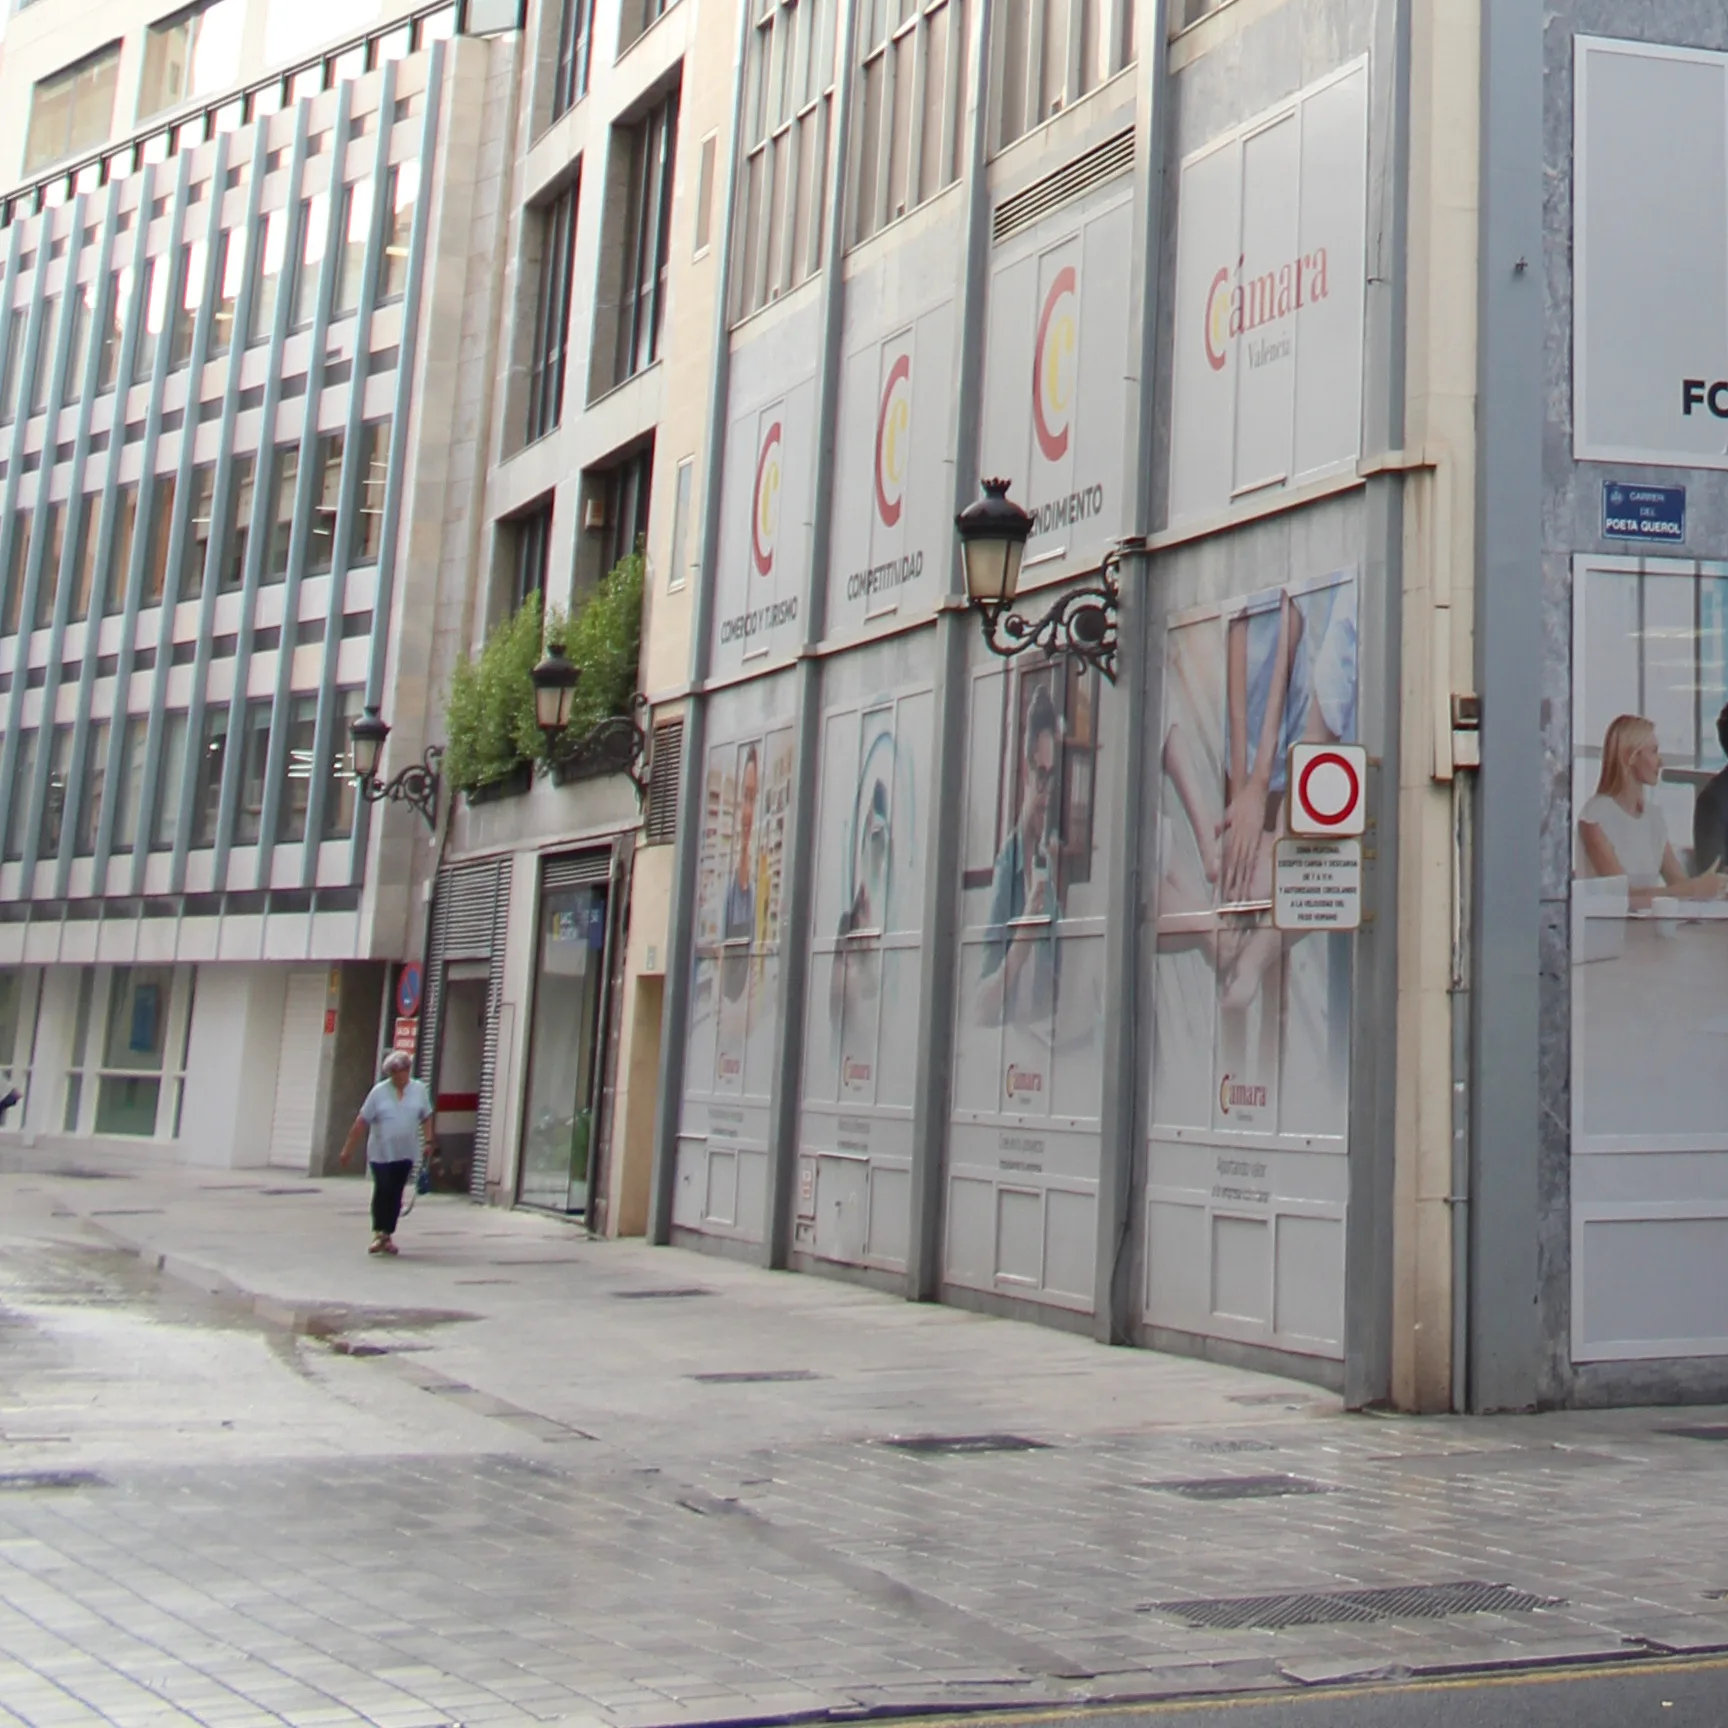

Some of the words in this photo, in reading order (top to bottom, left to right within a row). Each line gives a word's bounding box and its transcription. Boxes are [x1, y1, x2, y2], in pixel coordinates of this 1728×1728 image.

[1205, 247, 1329, 372] Cámara
[1248, 336, 1291, 370] Valencia
[1629, 491, 1665, 503] CARRER
[1640, 507, 1656, 517] DEL
[1606, 518, 1638, 532] POETA
[1640, 520, 1681, 535] QUEROL
[847, 550, 923, 601] COMPETITIVIDAD
